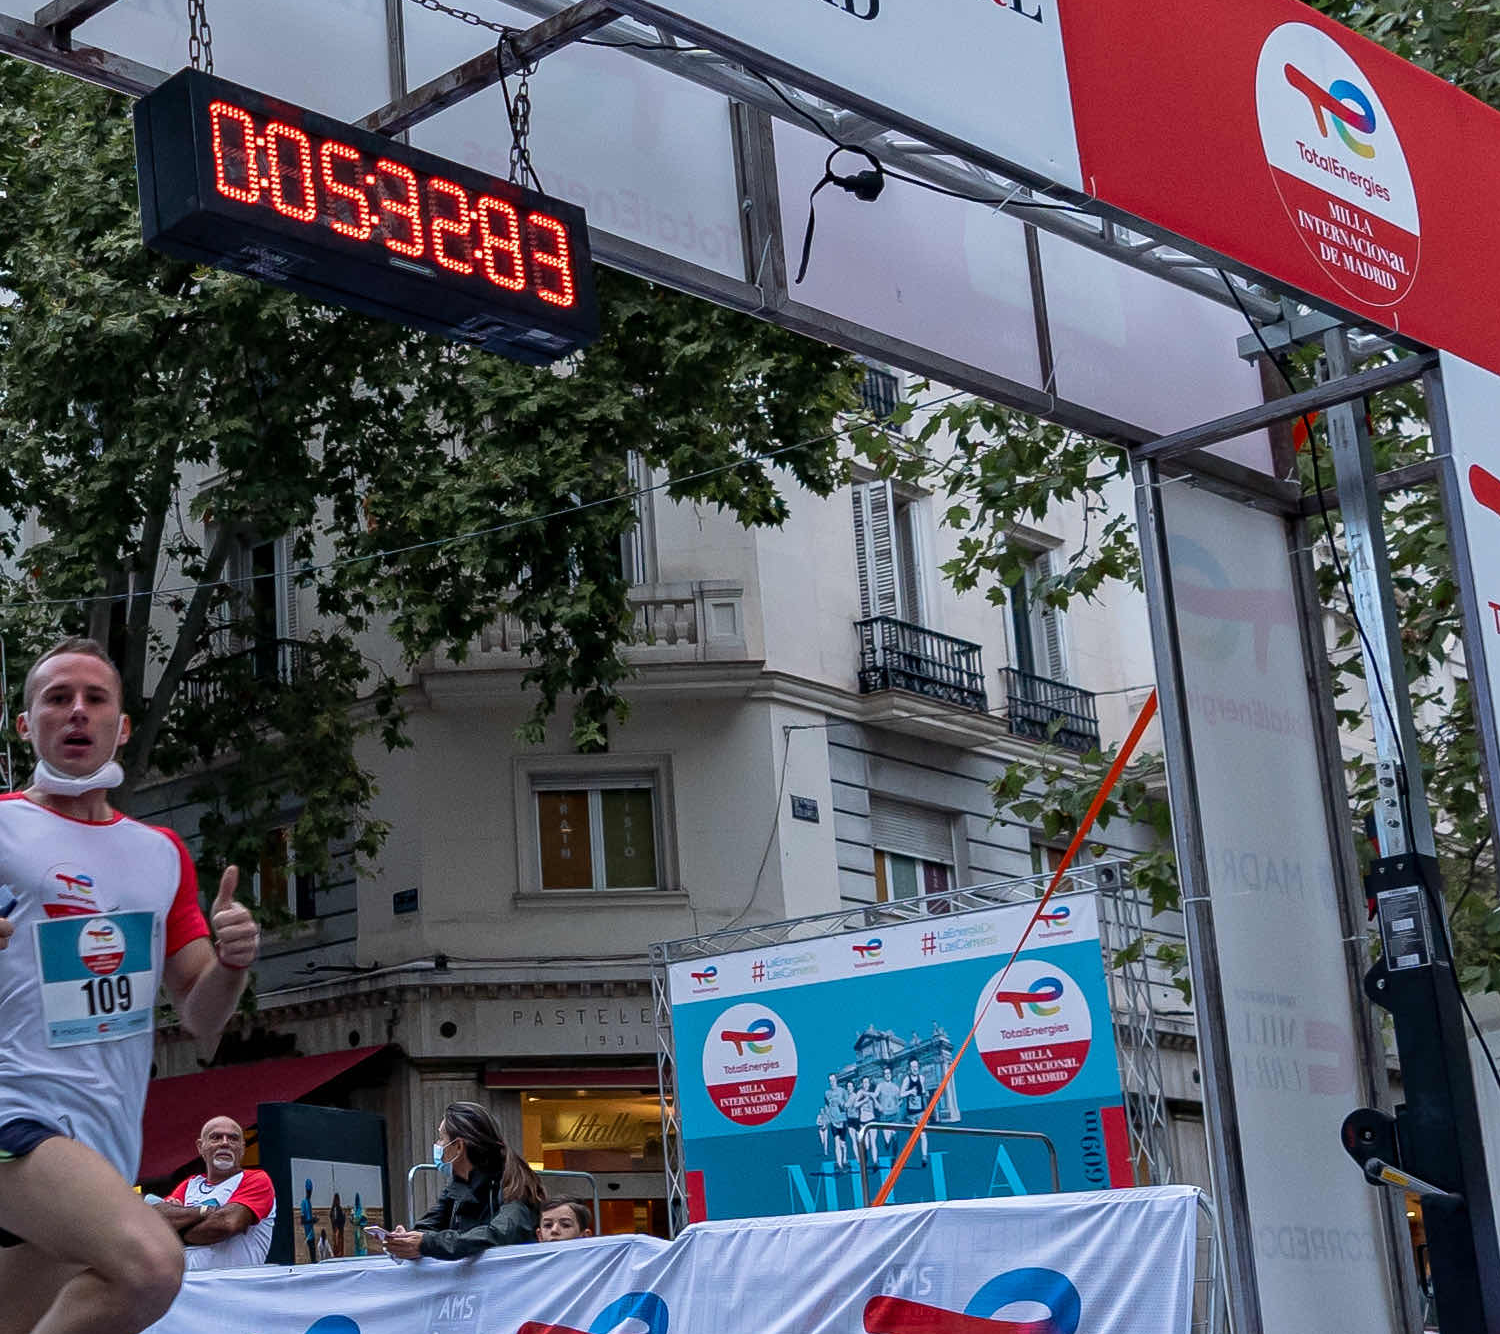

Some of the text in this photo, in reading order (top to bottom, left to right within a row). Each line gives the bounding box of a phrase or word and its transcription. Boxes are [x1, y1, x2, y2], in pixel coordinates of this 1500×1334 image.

[1296, 140, 1391, 202] TotalEnergies
[1328, 200, 1374, 237] MILLA
[1319, 241, 1397, 291] DE MADRID
[80, 975, 133, 1016] 109
[1000, 1023, 1069, 1040] TotalEnergies
[1020, 1048, 1053, 1060] MILLA
[722, 1061, 779, 1074] TotalEnergies
[1011, 1071, 1068, 1086] DE MADRID
[739, 1084, 766, 1093] MILLA
[731, 1104, 778, 1117] DE MADRID
